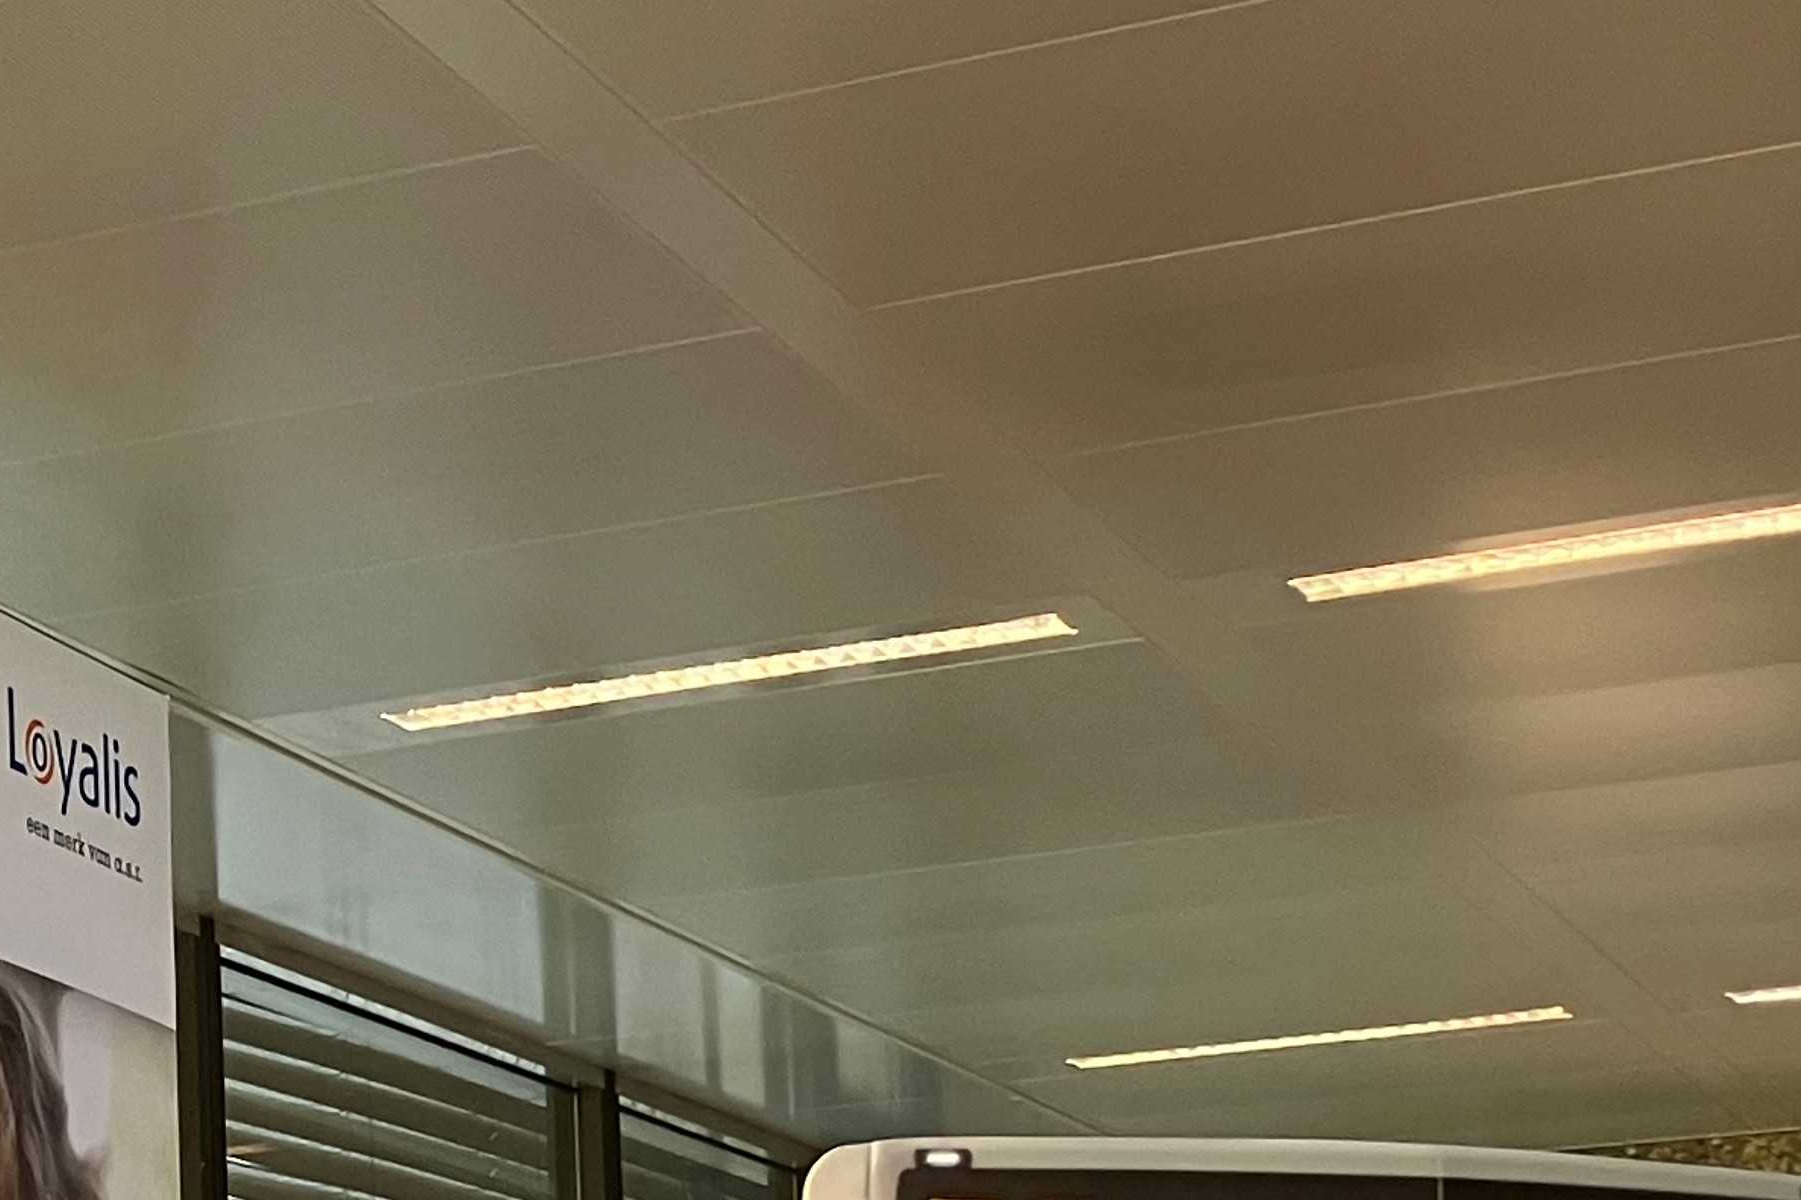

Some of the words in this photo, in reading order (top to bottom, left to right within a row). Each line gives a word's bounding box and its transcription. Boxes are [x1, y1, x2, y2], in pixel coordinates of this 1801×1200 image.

[7, 686, 141, 827] Loyalis
[26, 817, 50, 841] een
[53, 829, 85, 857] merk
